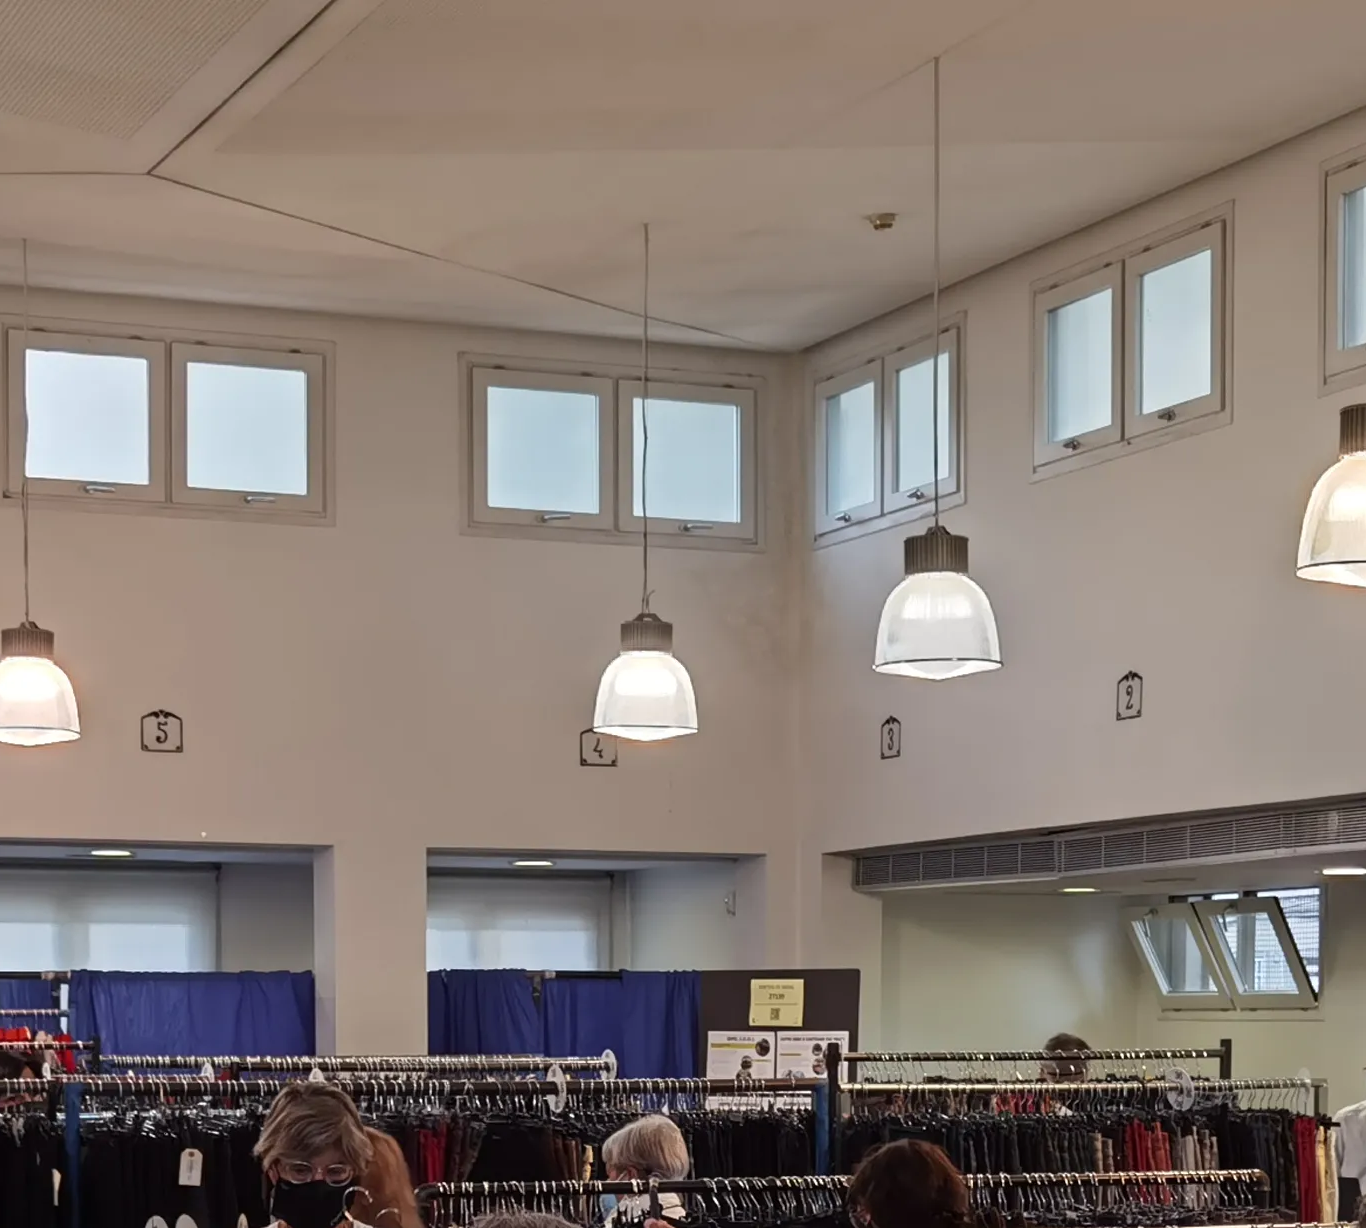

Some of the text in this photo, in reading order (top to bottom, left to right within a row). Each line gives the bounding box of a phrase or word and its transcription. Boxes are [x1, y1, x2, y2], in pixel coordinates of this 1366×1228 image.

[1125, 684, 1134, 710] 2
[155, 721, 168, 744] 5
[887, 727, 895, 751] 3
[592, 737, 604, 759] 4
